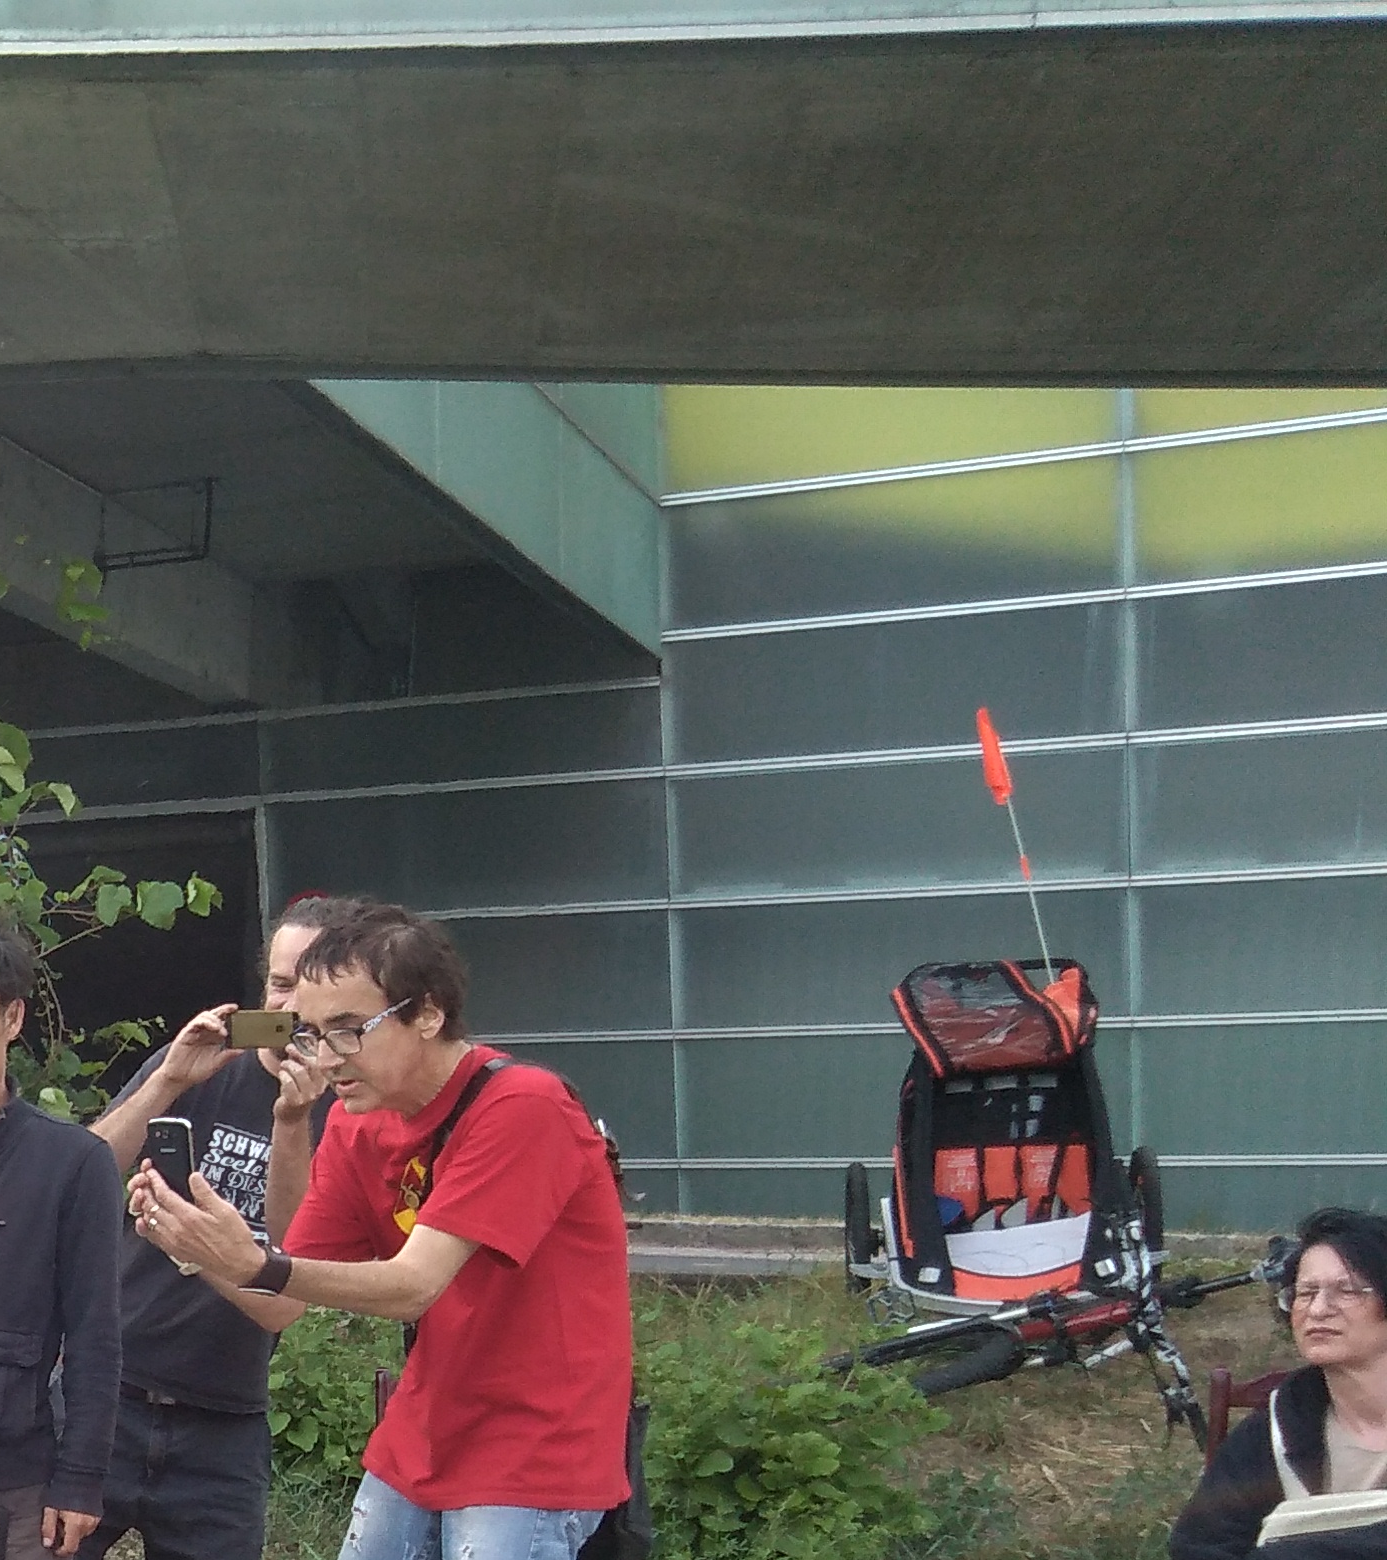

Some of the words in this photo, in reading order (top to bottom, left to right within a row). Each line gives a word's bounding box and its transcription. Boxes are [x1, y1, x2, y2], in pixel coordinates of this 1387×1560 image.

[209, 1129, 272, 1162] SCHWA
[203, 1149, 263, 1176] Seele
[227, 1170, 266, 1195] DIES
